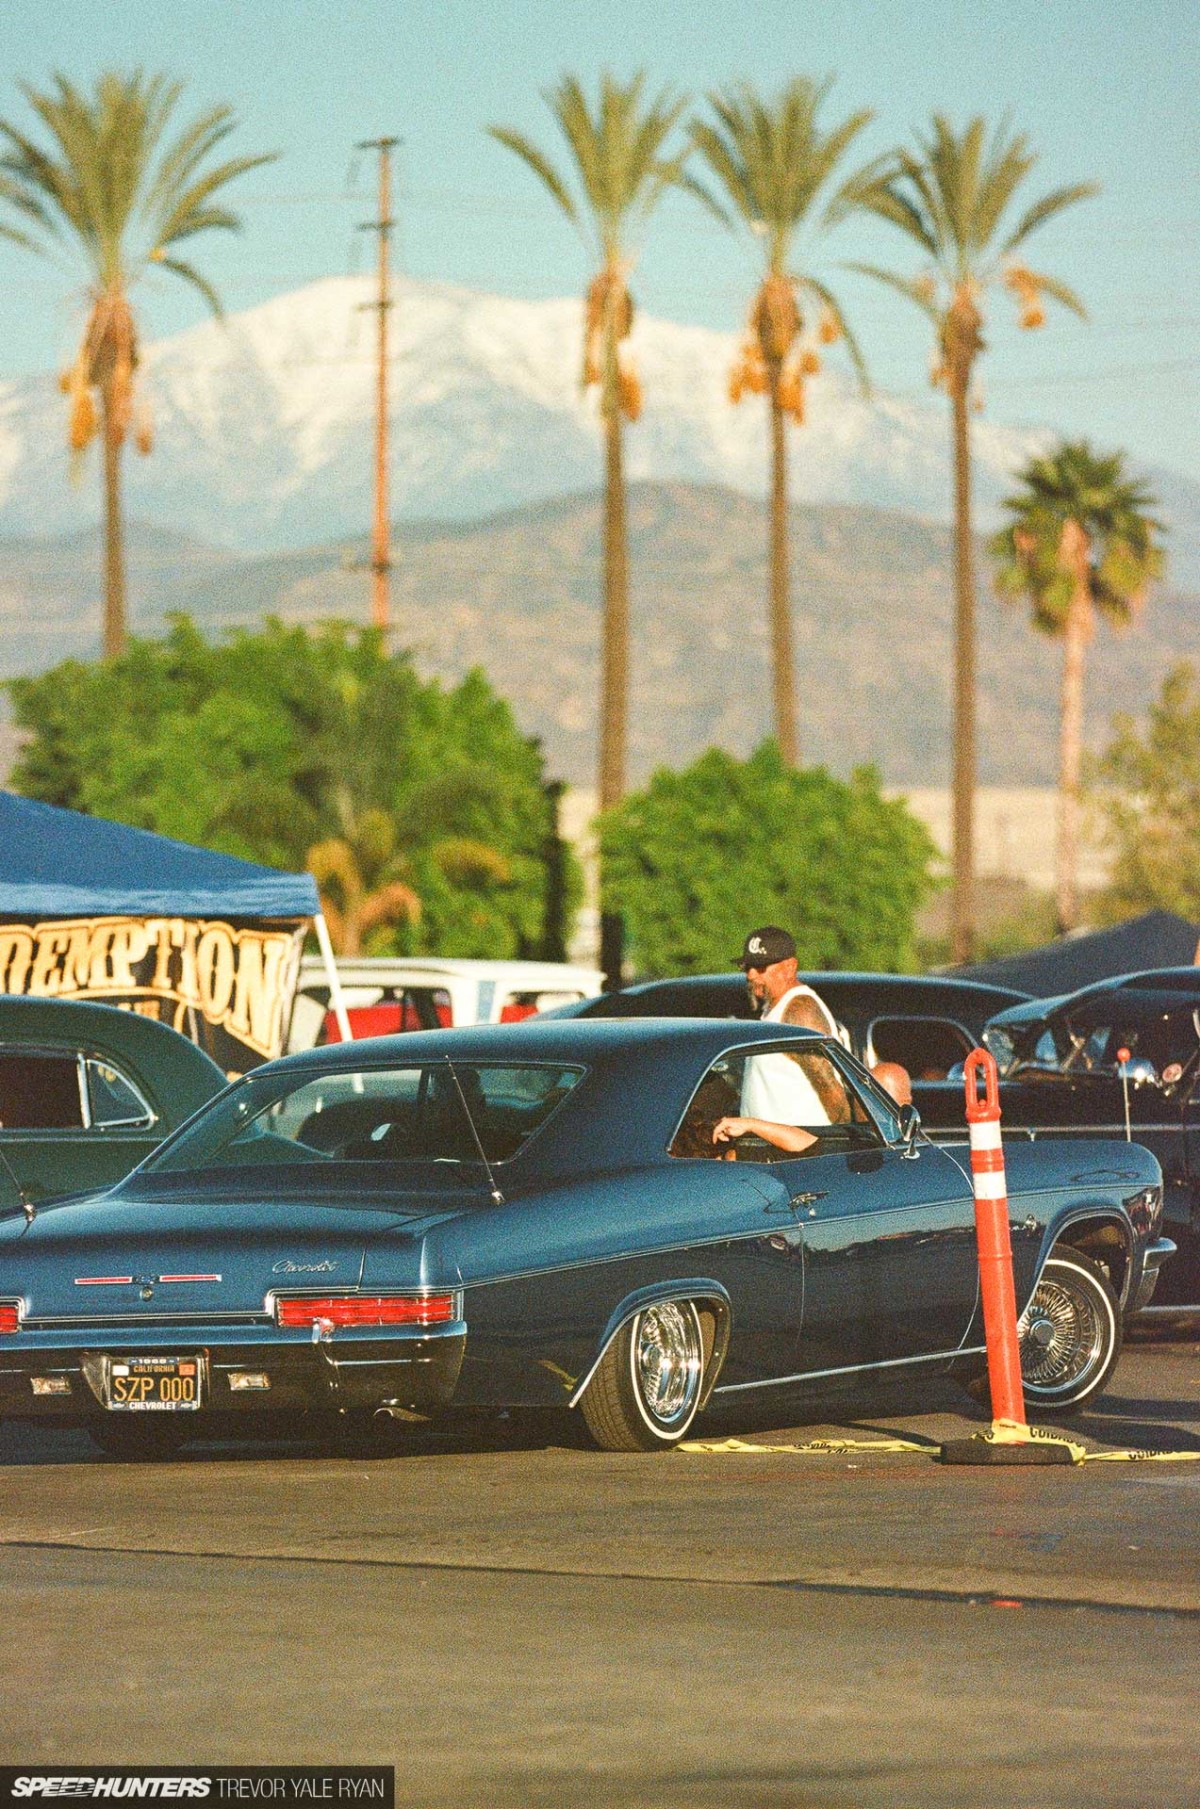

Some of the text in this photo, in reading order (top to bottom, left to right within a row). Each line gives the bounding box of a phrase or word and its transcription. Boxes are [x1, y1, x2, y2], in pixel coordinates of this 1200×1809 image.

[133, 1364, 175, 1373] CALIFORNIA
[113, 1377, 194, 1402] SZP 000
[129, 1401, 176, 1410] CHEVROLET
